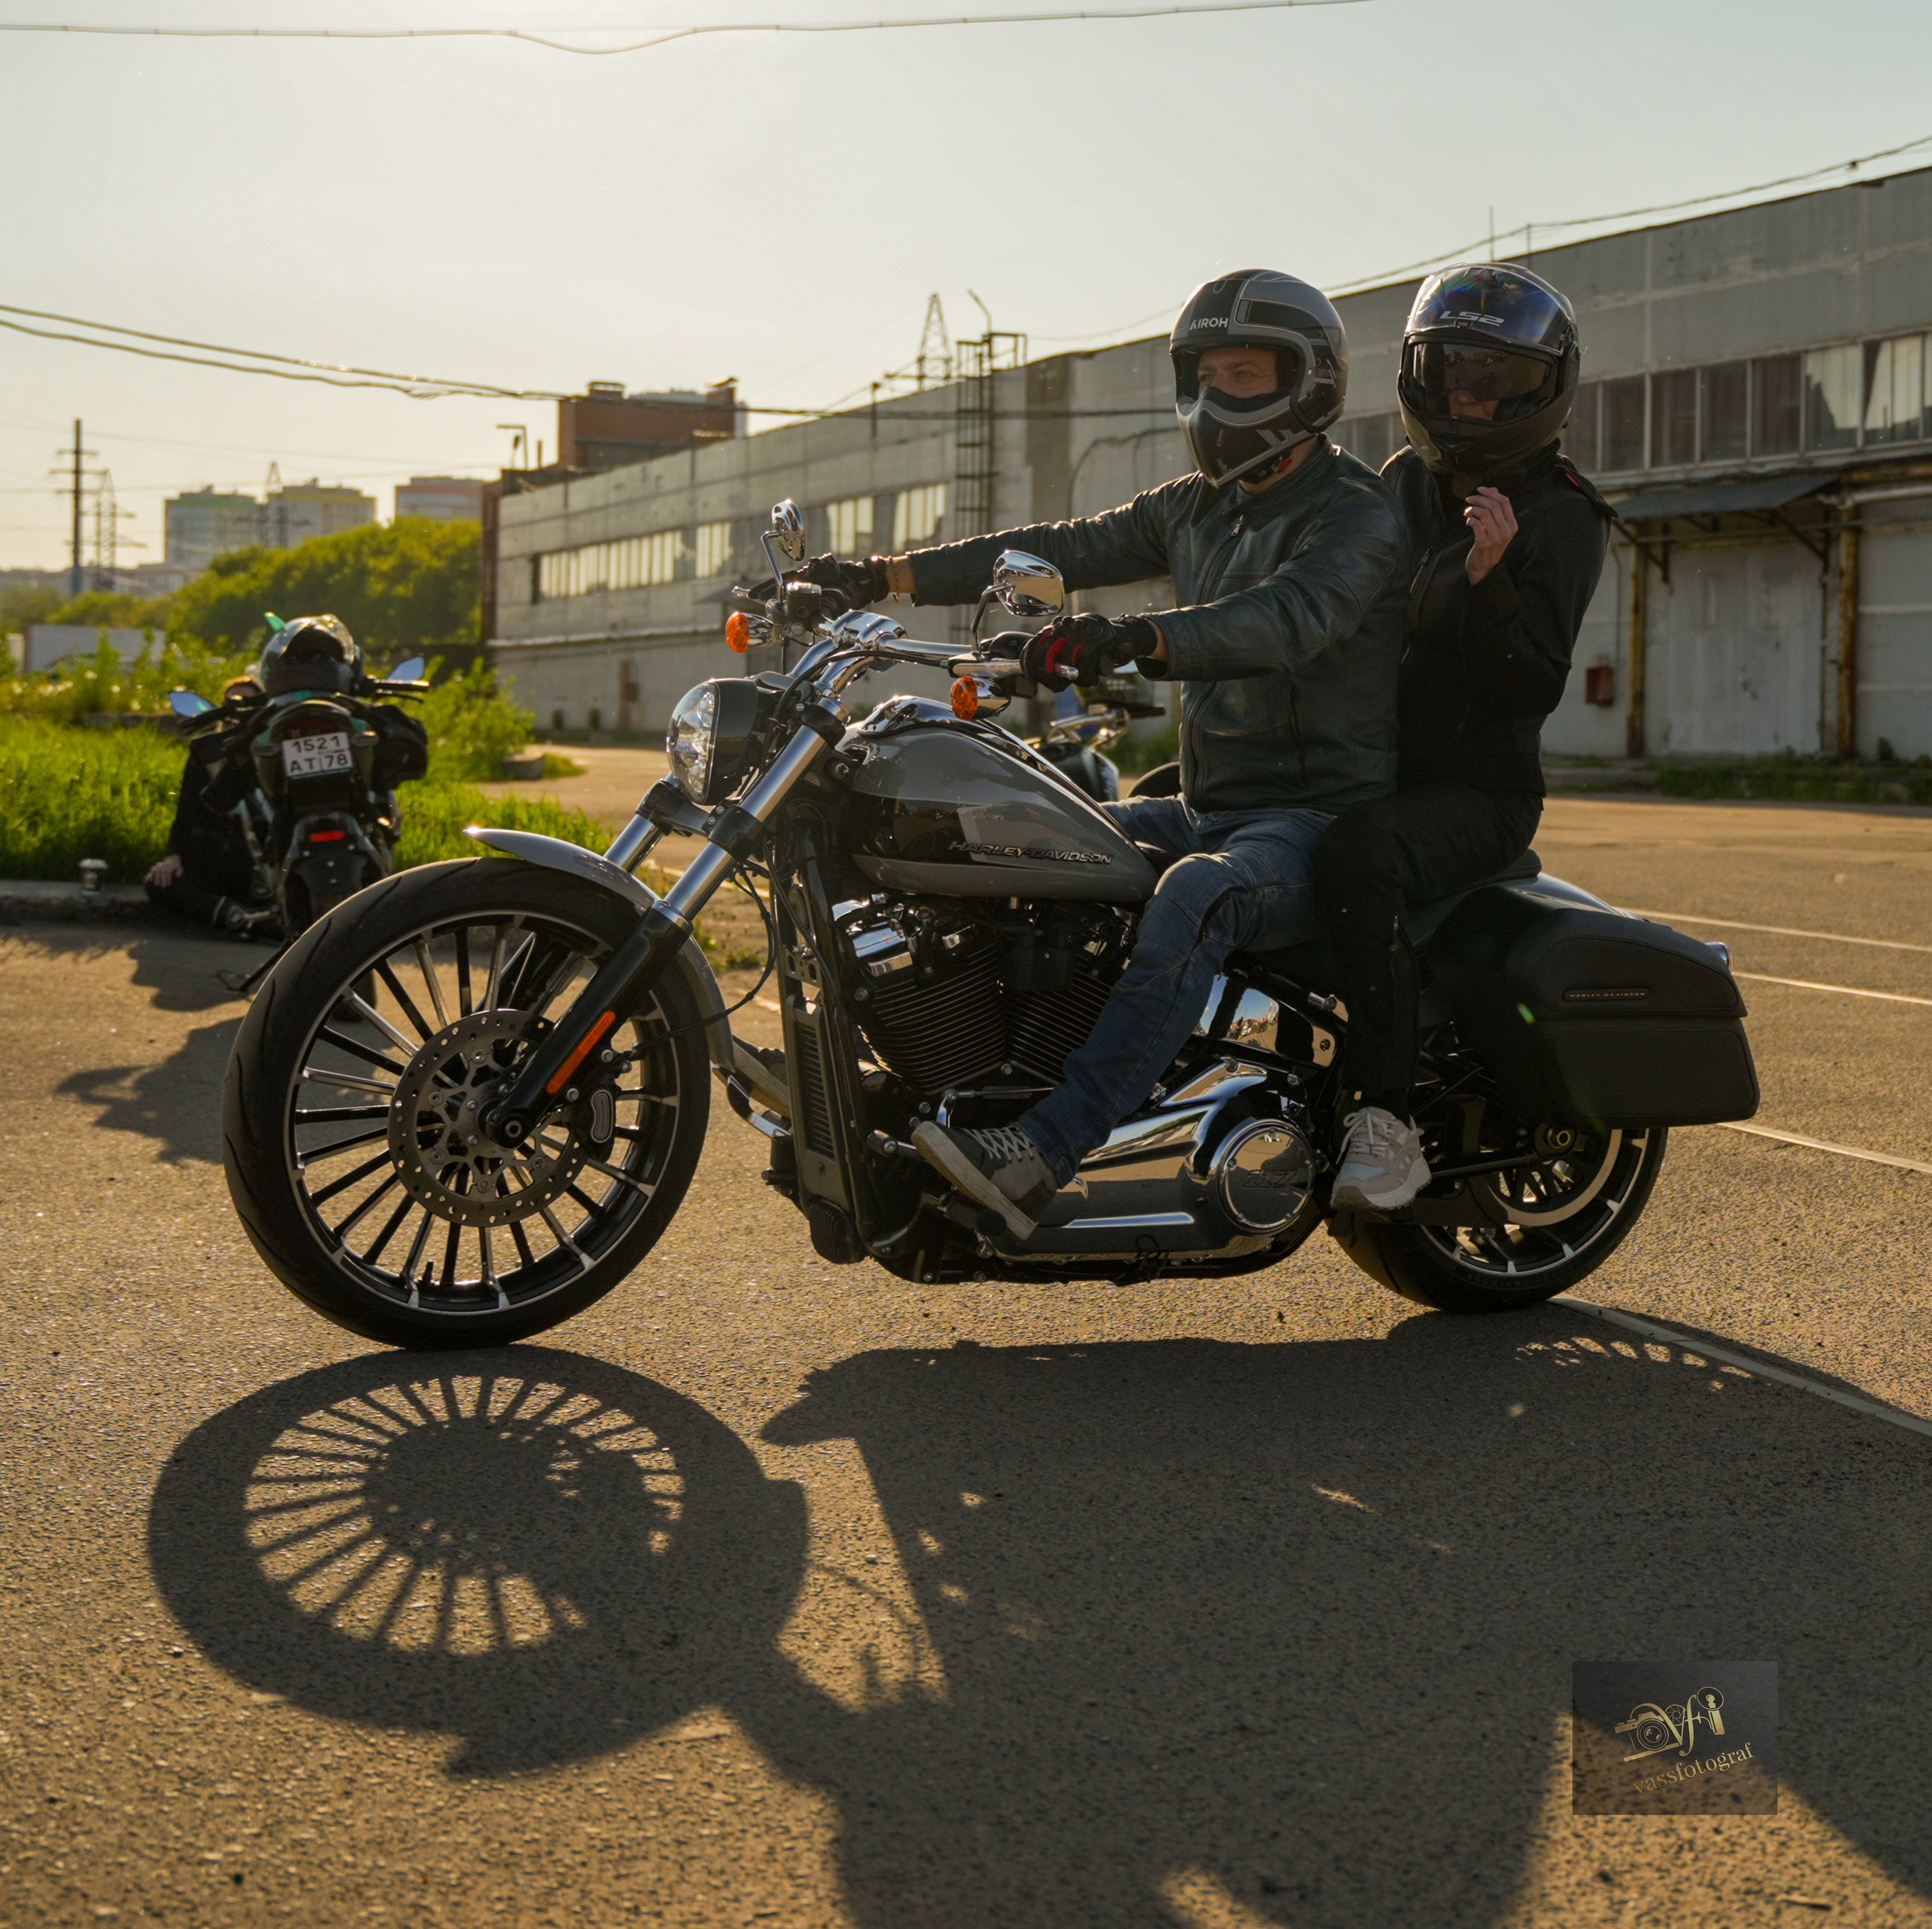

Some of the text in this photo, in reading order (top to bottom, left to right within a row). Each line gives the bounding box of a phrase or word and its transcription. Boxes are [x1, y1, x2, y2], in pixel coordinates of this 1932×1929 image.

[1189, 317, 1229, 331] AIROH
[1440, 310, 1505, 328] LS2
[291, 734, 341, 753] 1521
[324, 753, 348, 768] 78
[948, 840, 1113, 866] HARLEY-DAVIDSON
[1242, 1169, 1298, 1189] 117
